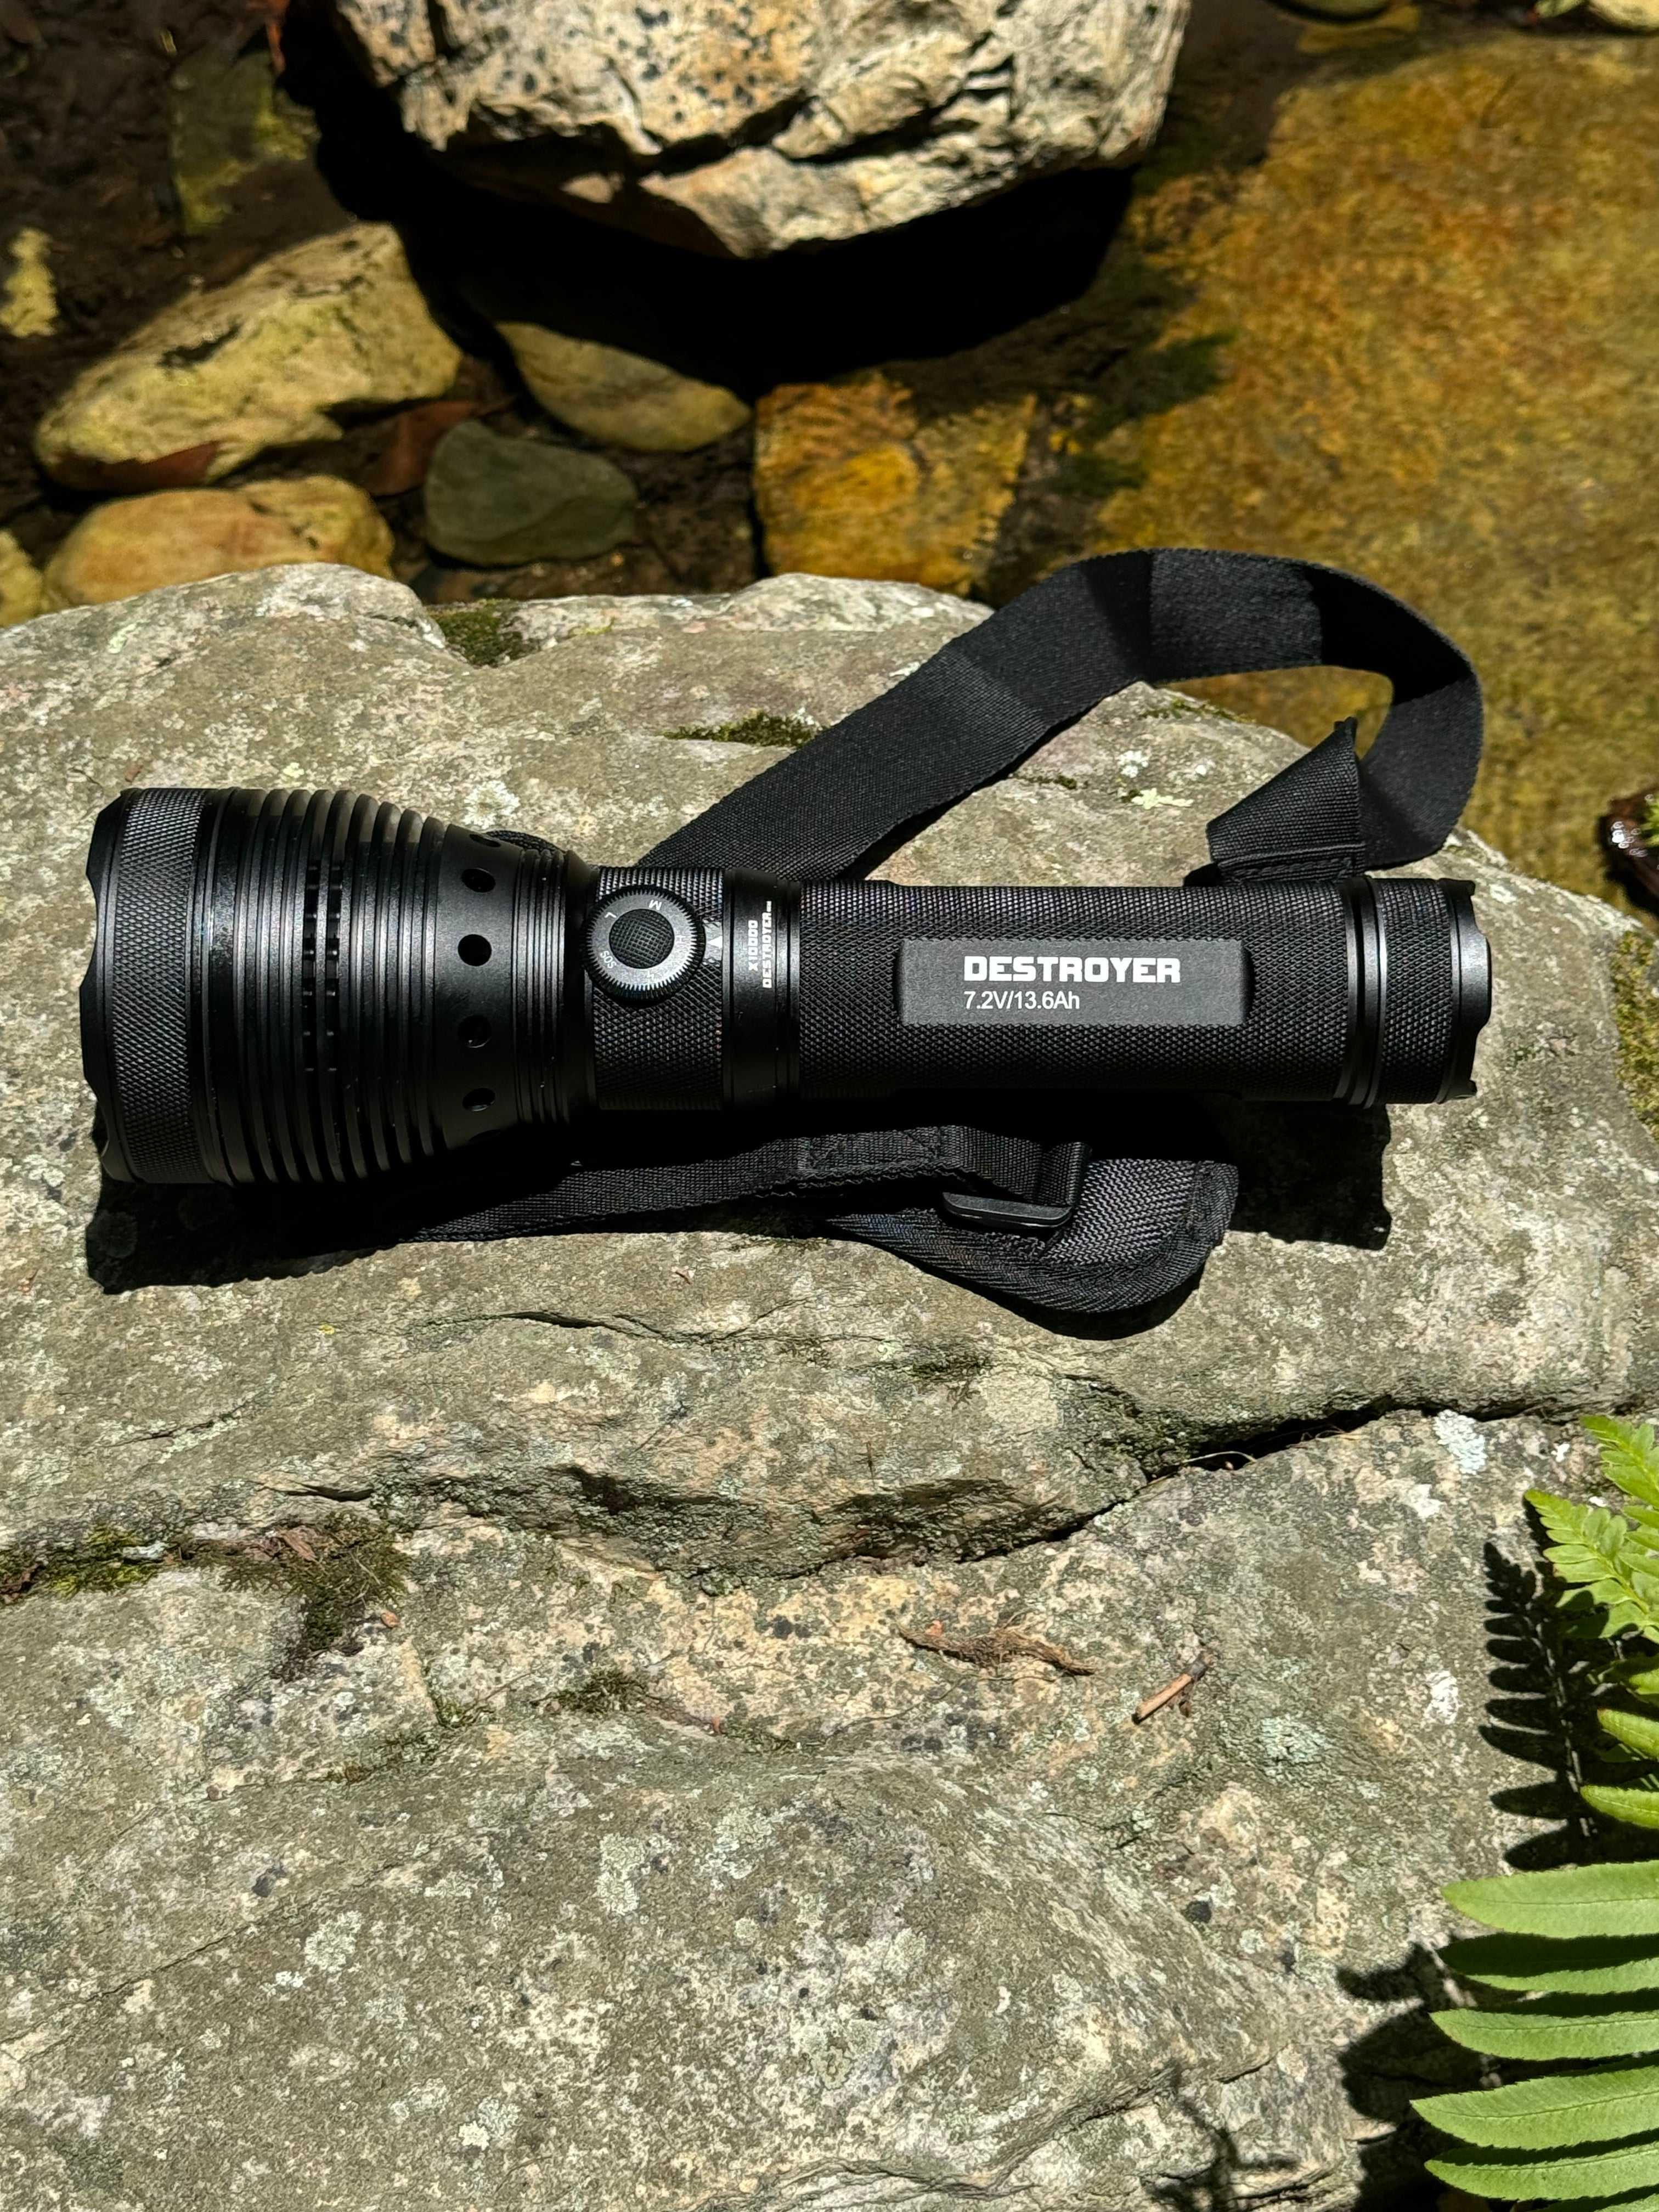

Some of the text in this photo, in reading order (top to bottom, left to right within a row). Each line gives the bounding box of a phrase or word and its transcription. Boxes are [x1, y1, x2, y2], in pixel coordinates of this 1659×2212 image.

[648, 900, 662, 911] M
[748, 920, 758, 971] X10000
[762, 912, 772, 988] DESTROYER
[600, 950, 617, 969] SOS
[964, 956, 1181, 983] DESTROYER
[964, 991, 1080, 1010] 7.2V/13.6Ah
